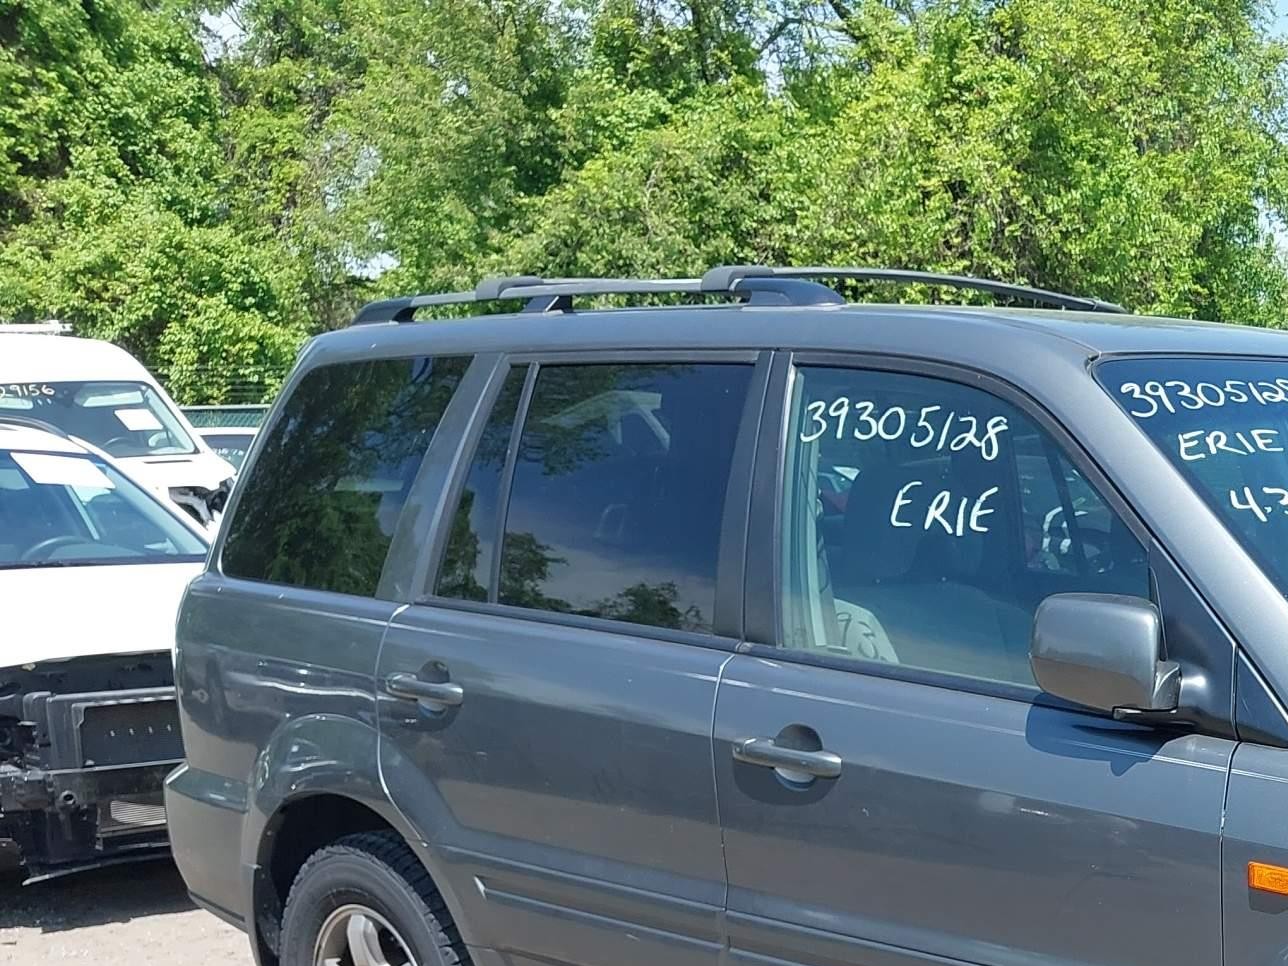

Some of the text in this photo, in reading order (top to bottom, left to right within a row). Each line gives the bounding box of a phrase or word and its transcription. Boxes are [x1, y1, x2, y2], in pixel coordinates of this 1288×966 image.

[800, 397, 1009, 461] 39305128
[1178, 429, 1284, 461] ERIE
[890, 481, 999, 537] ERIE
